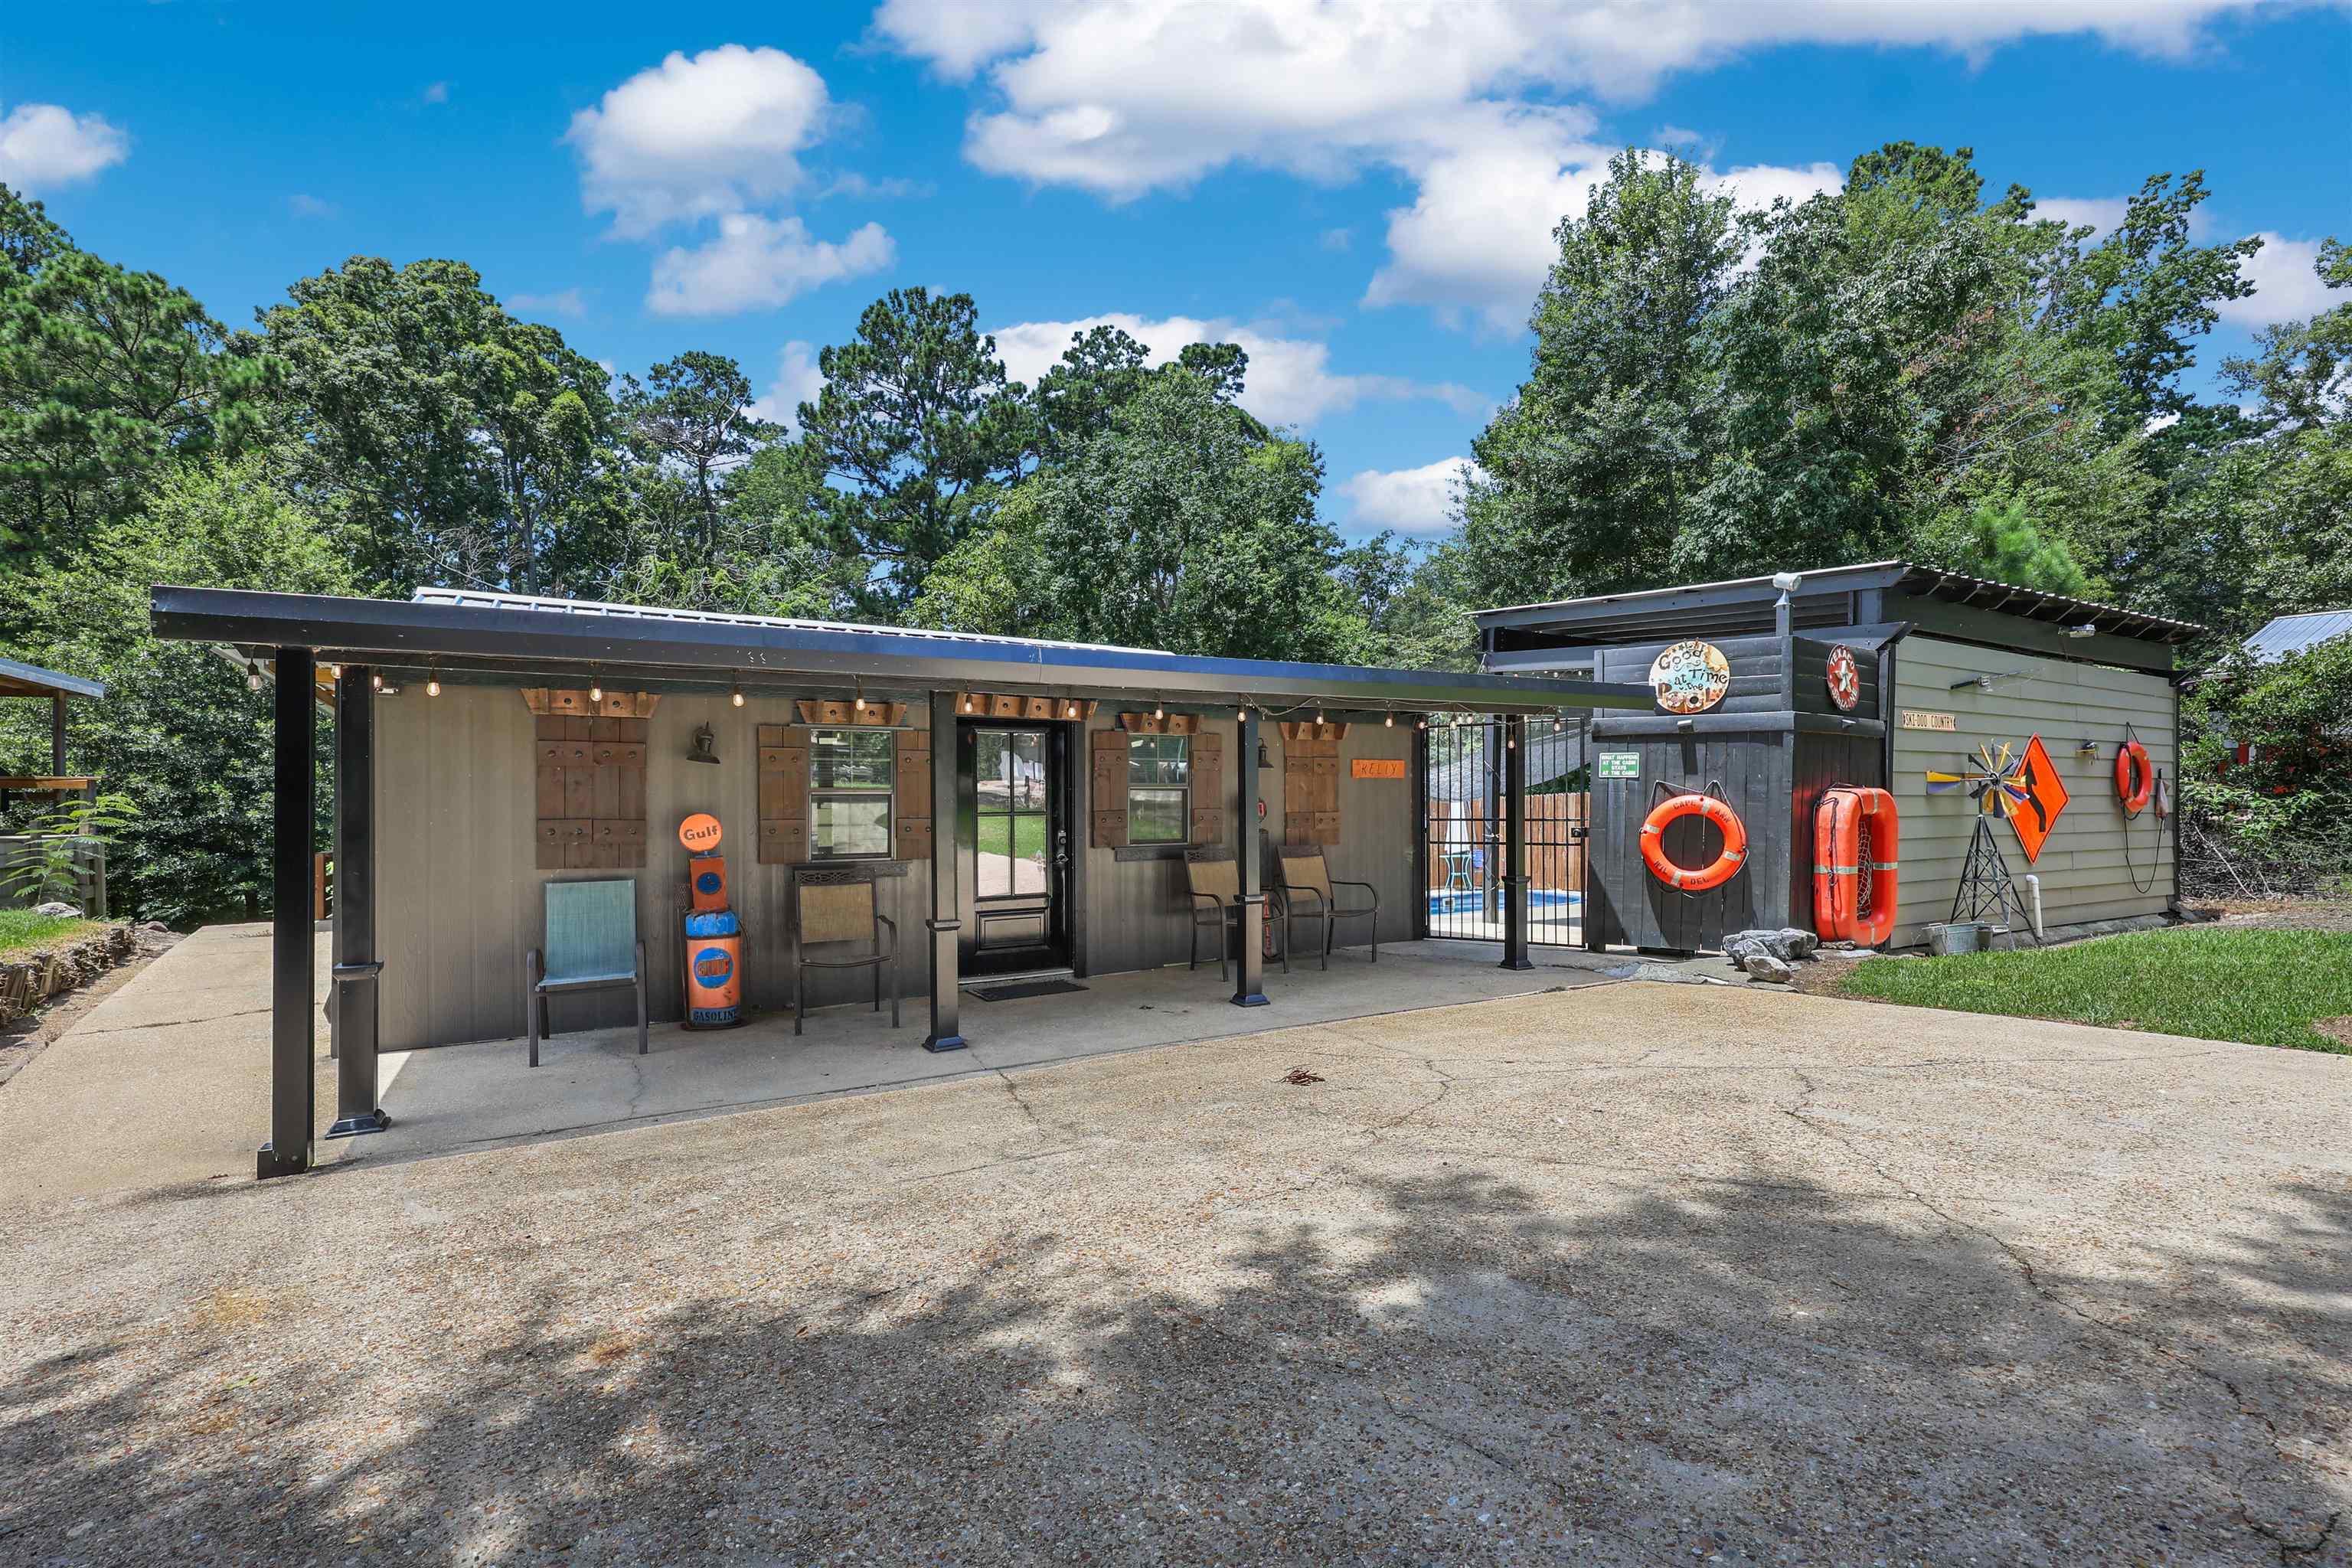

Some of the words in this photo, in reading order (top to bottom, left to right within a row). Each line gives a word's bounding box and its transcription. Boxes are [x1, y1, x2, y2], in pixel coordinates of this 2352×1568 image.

[1659, 645, 1705, 670] Good
[1830, 648, 1855, 669] TEXACO
[1674, 675, 1687, 685] at
[1689, 669, 1728, 684] Time
[1931, 715, 1954, 729] COUNTRY
[1673, 799, 1697, 809] CAPE
[684, 825, 717, 841] Gulf
[1690, 877, 1710, 885] DEL
[694, 1009, 735, 1022] GASOLIN
